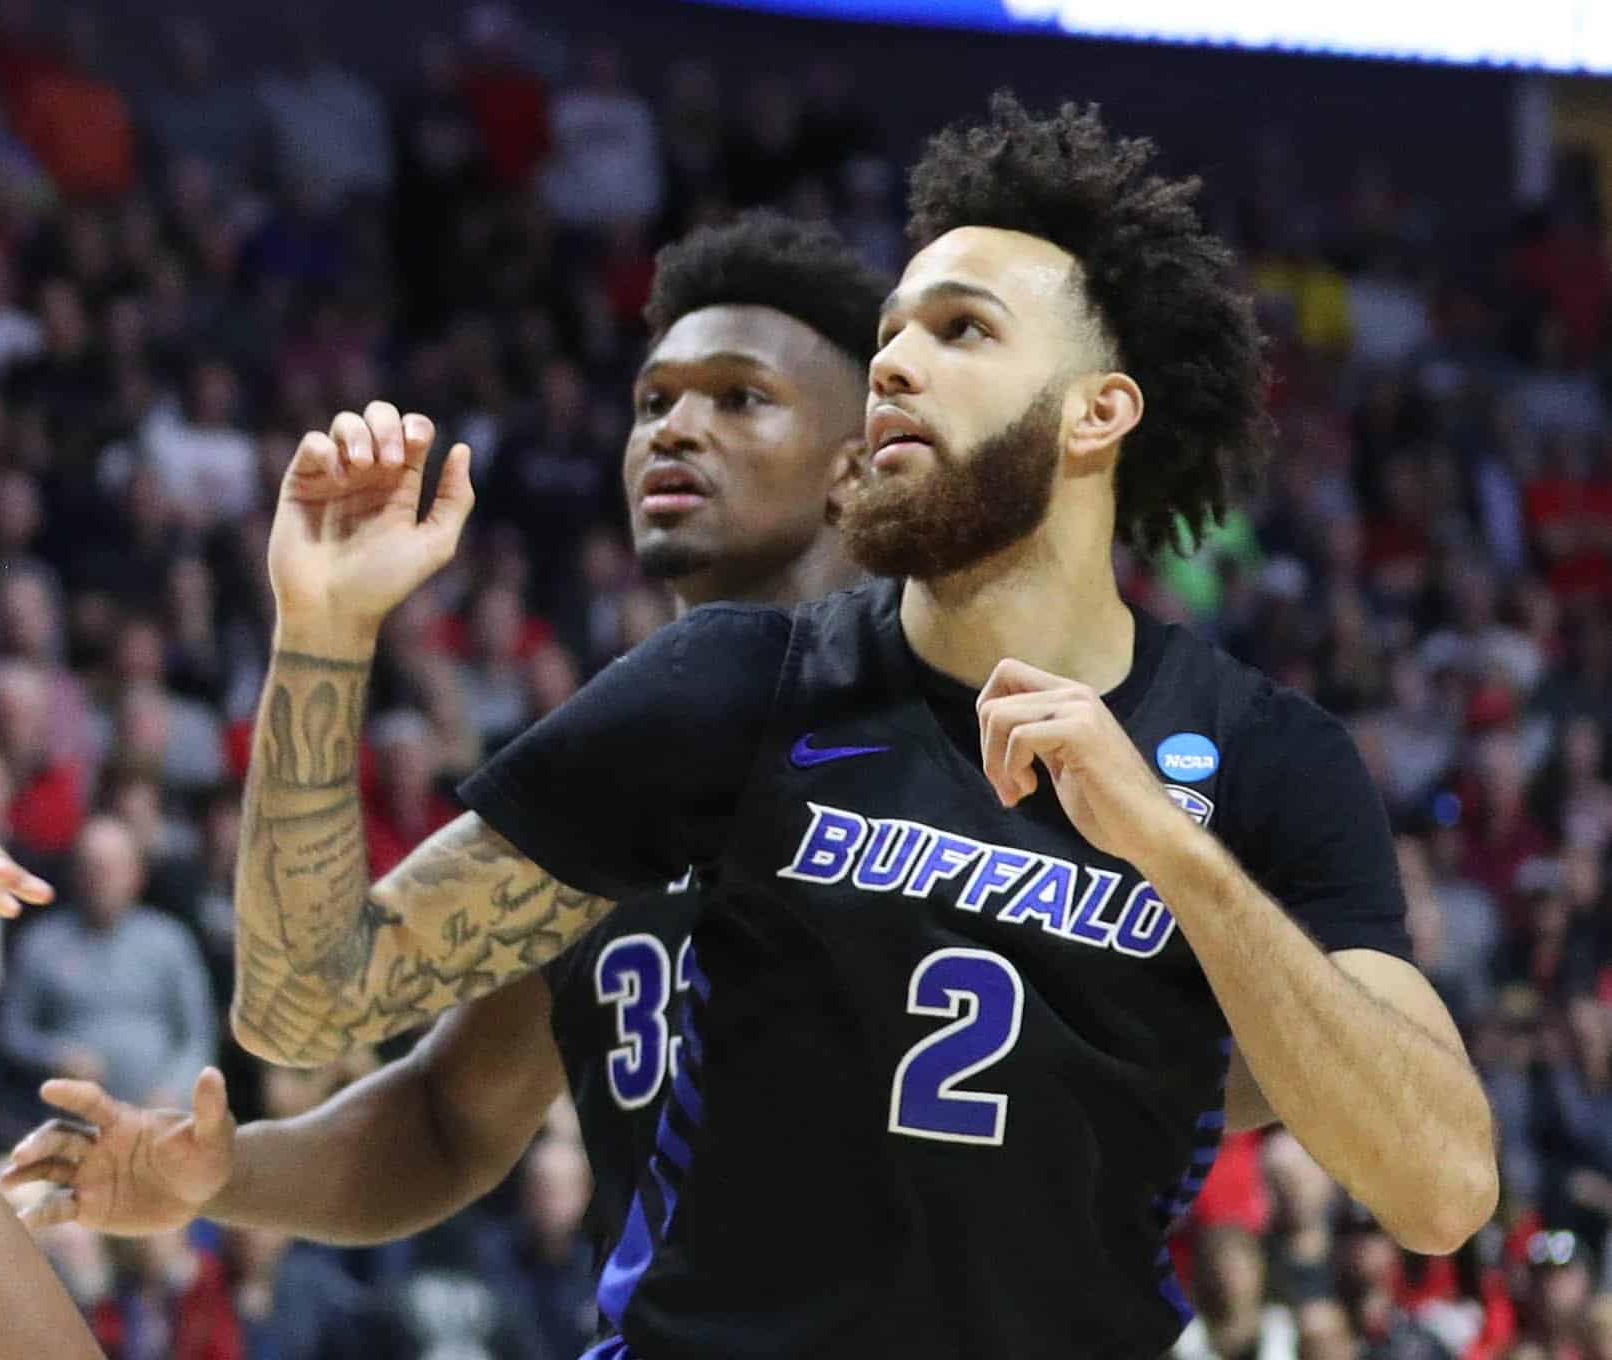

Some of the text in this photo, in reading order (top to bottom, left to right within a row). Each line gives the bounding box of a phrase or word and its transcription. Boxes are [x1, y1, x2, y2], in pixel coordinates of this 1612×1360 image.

[776, 800, 1175, 959] BUFFALO
[595, 932, 693, 1110] 3
[888, 947, 1025, 1146] 2
